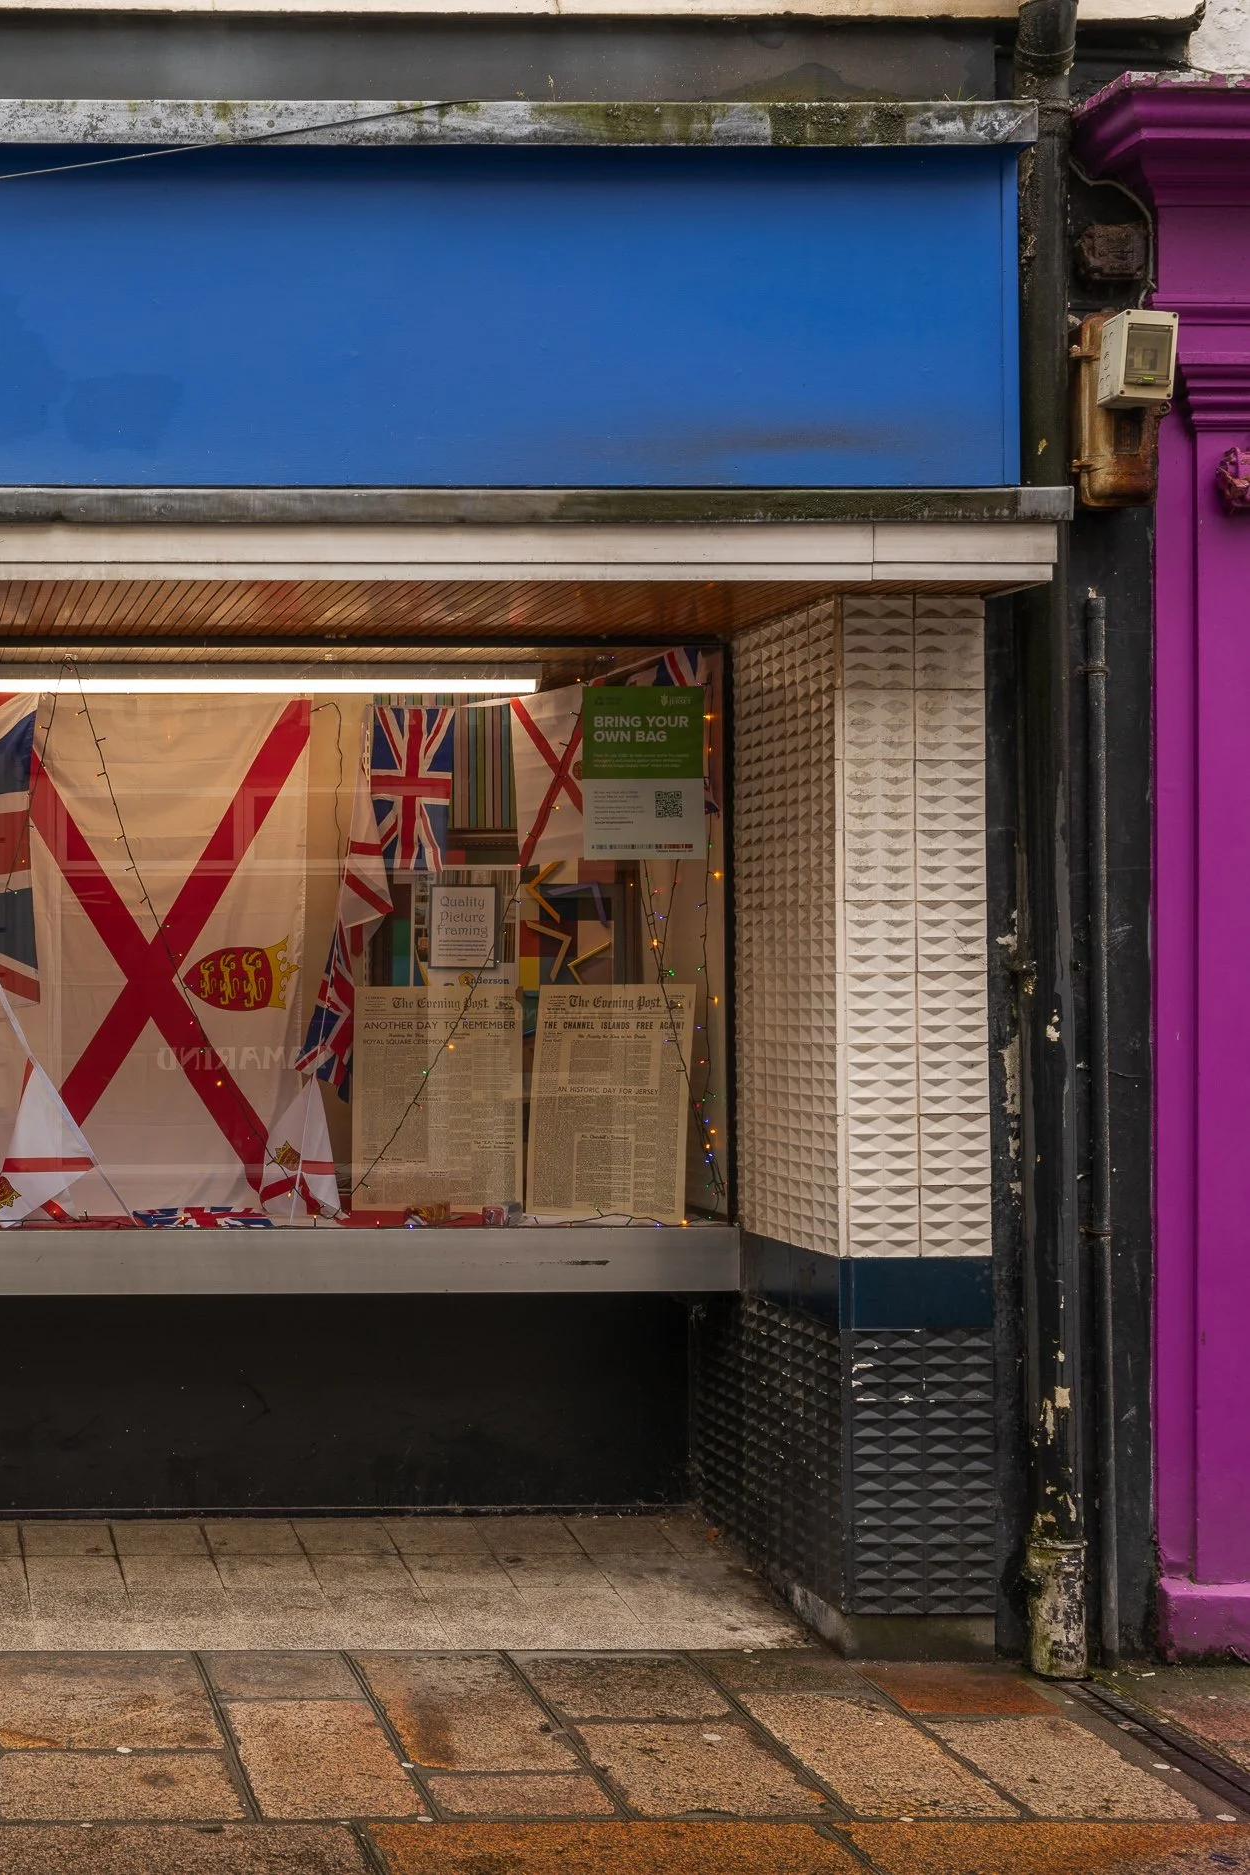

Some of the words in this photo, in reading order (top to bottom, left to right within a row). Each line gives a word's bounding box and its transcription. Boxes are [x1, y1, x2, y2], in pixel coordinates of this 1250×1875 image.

[593, 716, 642, 728] BRING
[646, 716, 689, 728] YOUR
[593, 730, 631, 742] OWN
[635, 730, 668, 742] BAG
[440, 896, 485, 909] Quality
[439, 911, 485, 924] Picture
[437, 924, 488, 938] Framing
[464, 976, 510, 985] Anderson
[392, 997, 414, 1009] The
[416, 997, 461, 1012] Evening
[569, 994, 590, 1008] The
[593, 995, 634, 1010] Evening
[363, 1021, 413, 1030] ANOTHER
[416, 1021, 438, 1030] DAY
[444, 1021, 458, 1030] TO
[462, 1021, 515, 1030] REMEMBER
[543, 1021, 557, 1029] THE
[563, 1021, 594, 1029] CHANNEL
[601, 1021, 630, 1029] ISLANDS
[636, 1021, 654, 1029] FREE
